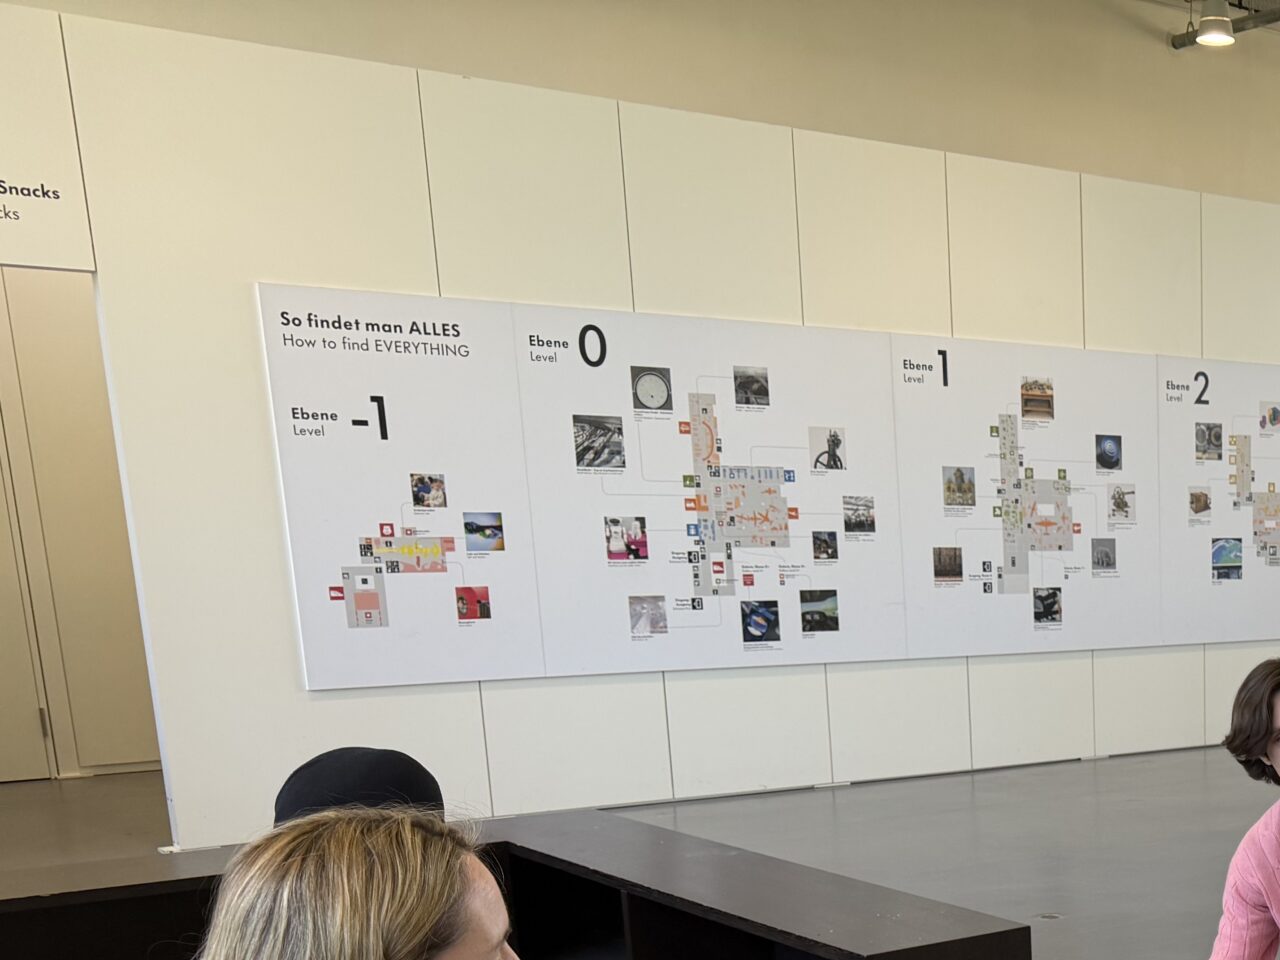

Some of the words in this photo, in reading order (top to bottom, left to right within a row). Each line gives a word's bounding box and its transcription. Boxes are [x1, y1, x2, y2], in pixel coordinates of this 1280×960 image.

[0, 179, 61, 199] Snacks
[280, 311, 302, 327] So
[307, 312, 361, 331] findet
[365, 322, 403, 334] man
[408, 321, 461, 337] ALLES
[282, 333, 316, 348] How
[322, 337, 337, 350] to
[341, 336, 369, 352] find
[374, 339, 470, 358] EVERYTHING
[529, 334, 569, 349] Ebene
[578, 324, 607, 368] 0
[530, 351, 557, 363] Level
[903, 359, 933, 372] Ebene
[937, 349, 949, 387] 1
[903, 373, 925, 384] Level
[1166, 380, 1190, 391] Ebene
[1193, 371, 1210, 405] 2
[1166, 393, 1183, 402] Level
[291, 407, 338, 421] Ebene
[293, 424, 325, 437] Level
